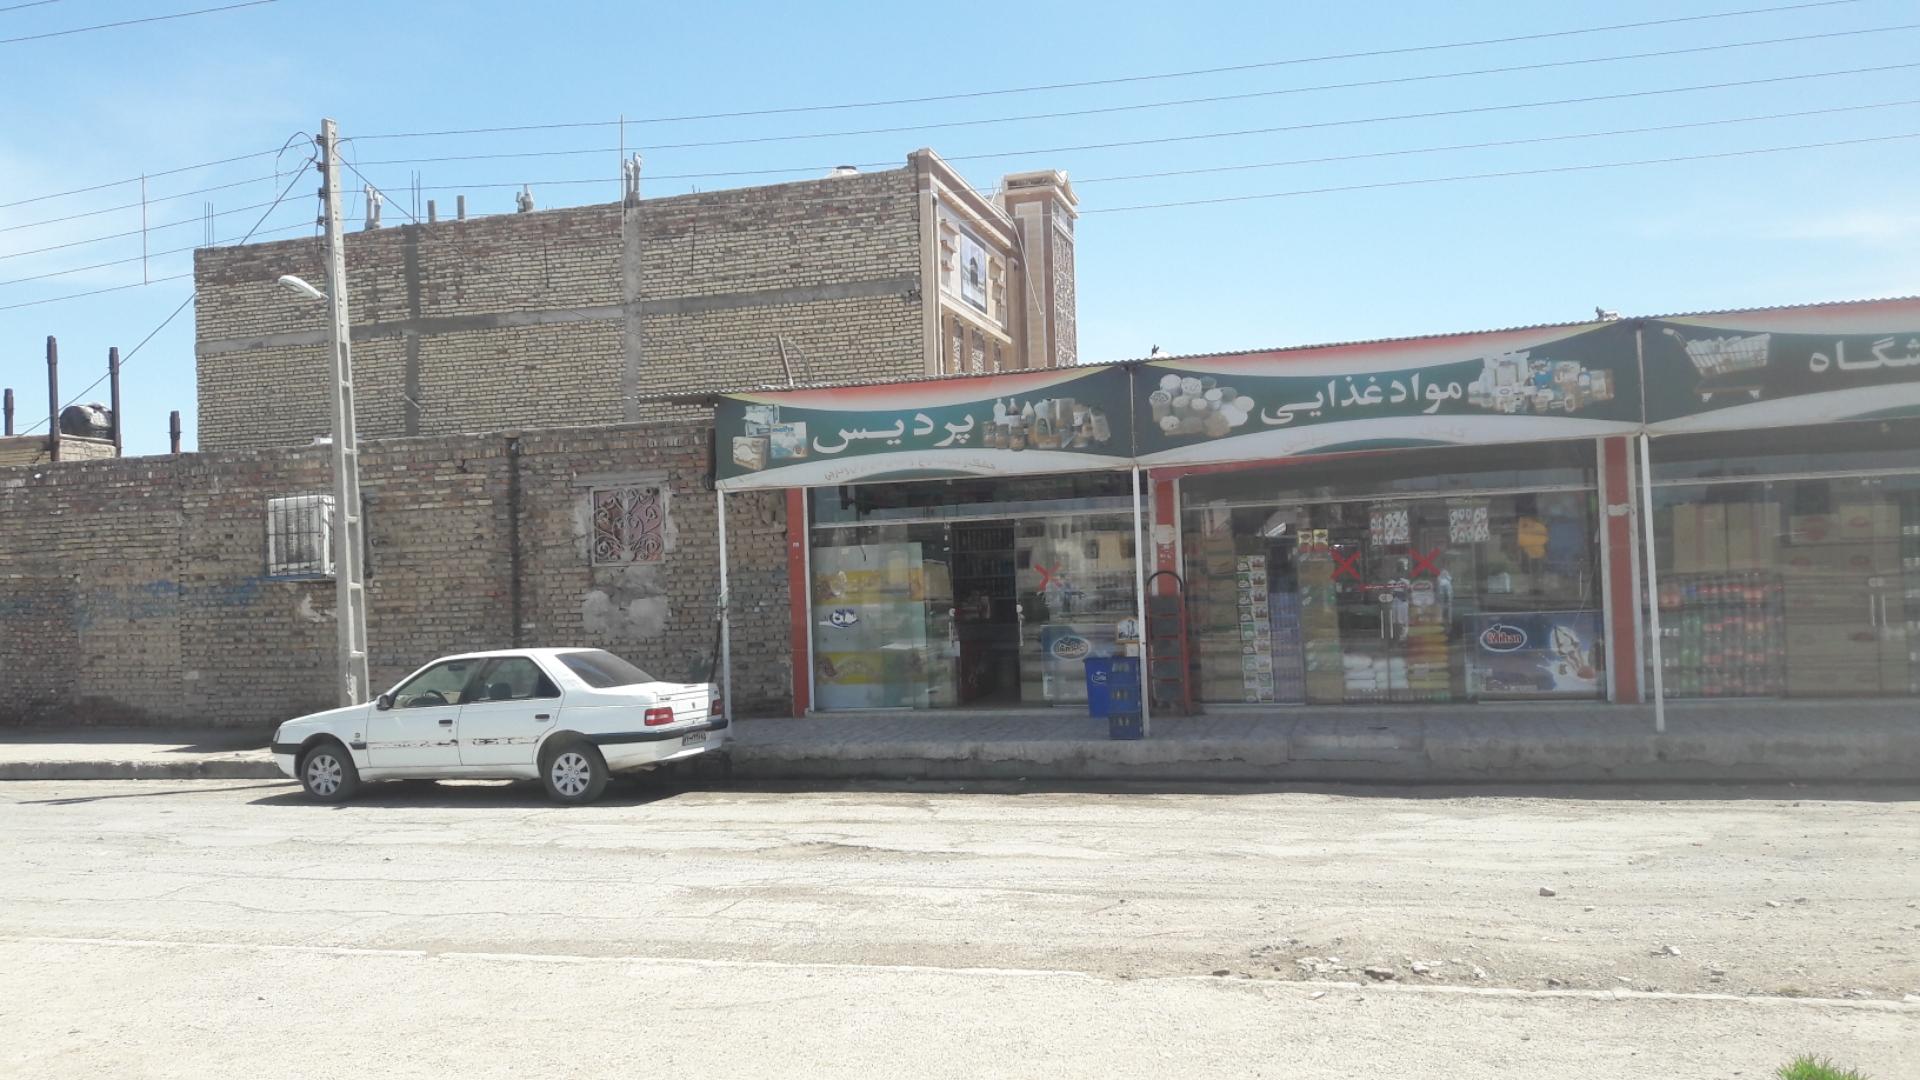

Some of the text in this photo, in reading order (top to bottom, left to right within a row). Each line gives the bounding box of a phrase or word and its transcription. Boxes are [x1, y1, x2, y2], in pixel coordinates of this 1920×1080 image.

[1260, 373, 1462, 426] مواد غذایی
[812, 412, 975, 455] پردیس
